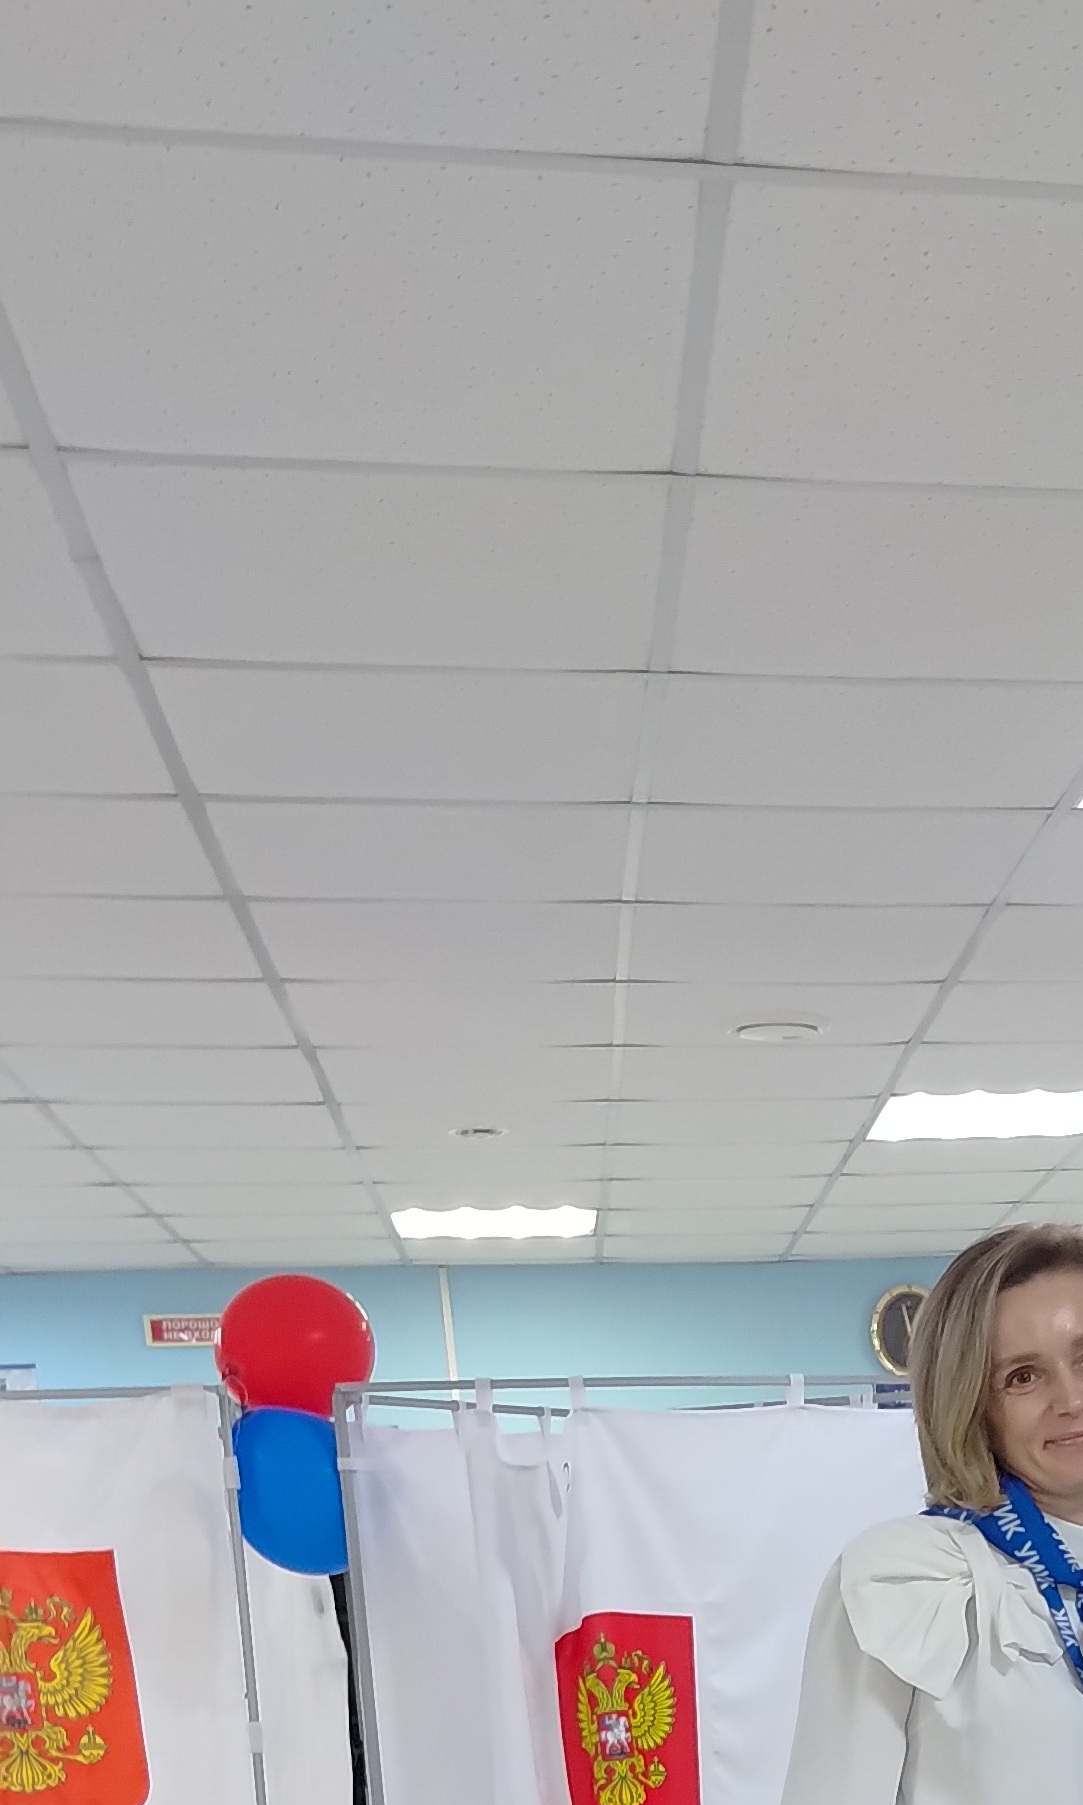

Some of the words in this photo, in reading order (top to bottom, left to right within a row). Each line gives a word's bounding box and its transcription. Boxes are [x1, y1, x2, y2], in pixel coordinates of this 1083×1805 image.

[163, 1319, 219, 1330] ПОРОШО
[994, 1500, 1026, 1541] ИК
[1014, 1540, 1055, 1590] УИК
[1051, 1607, 1082, 1648] УИК
